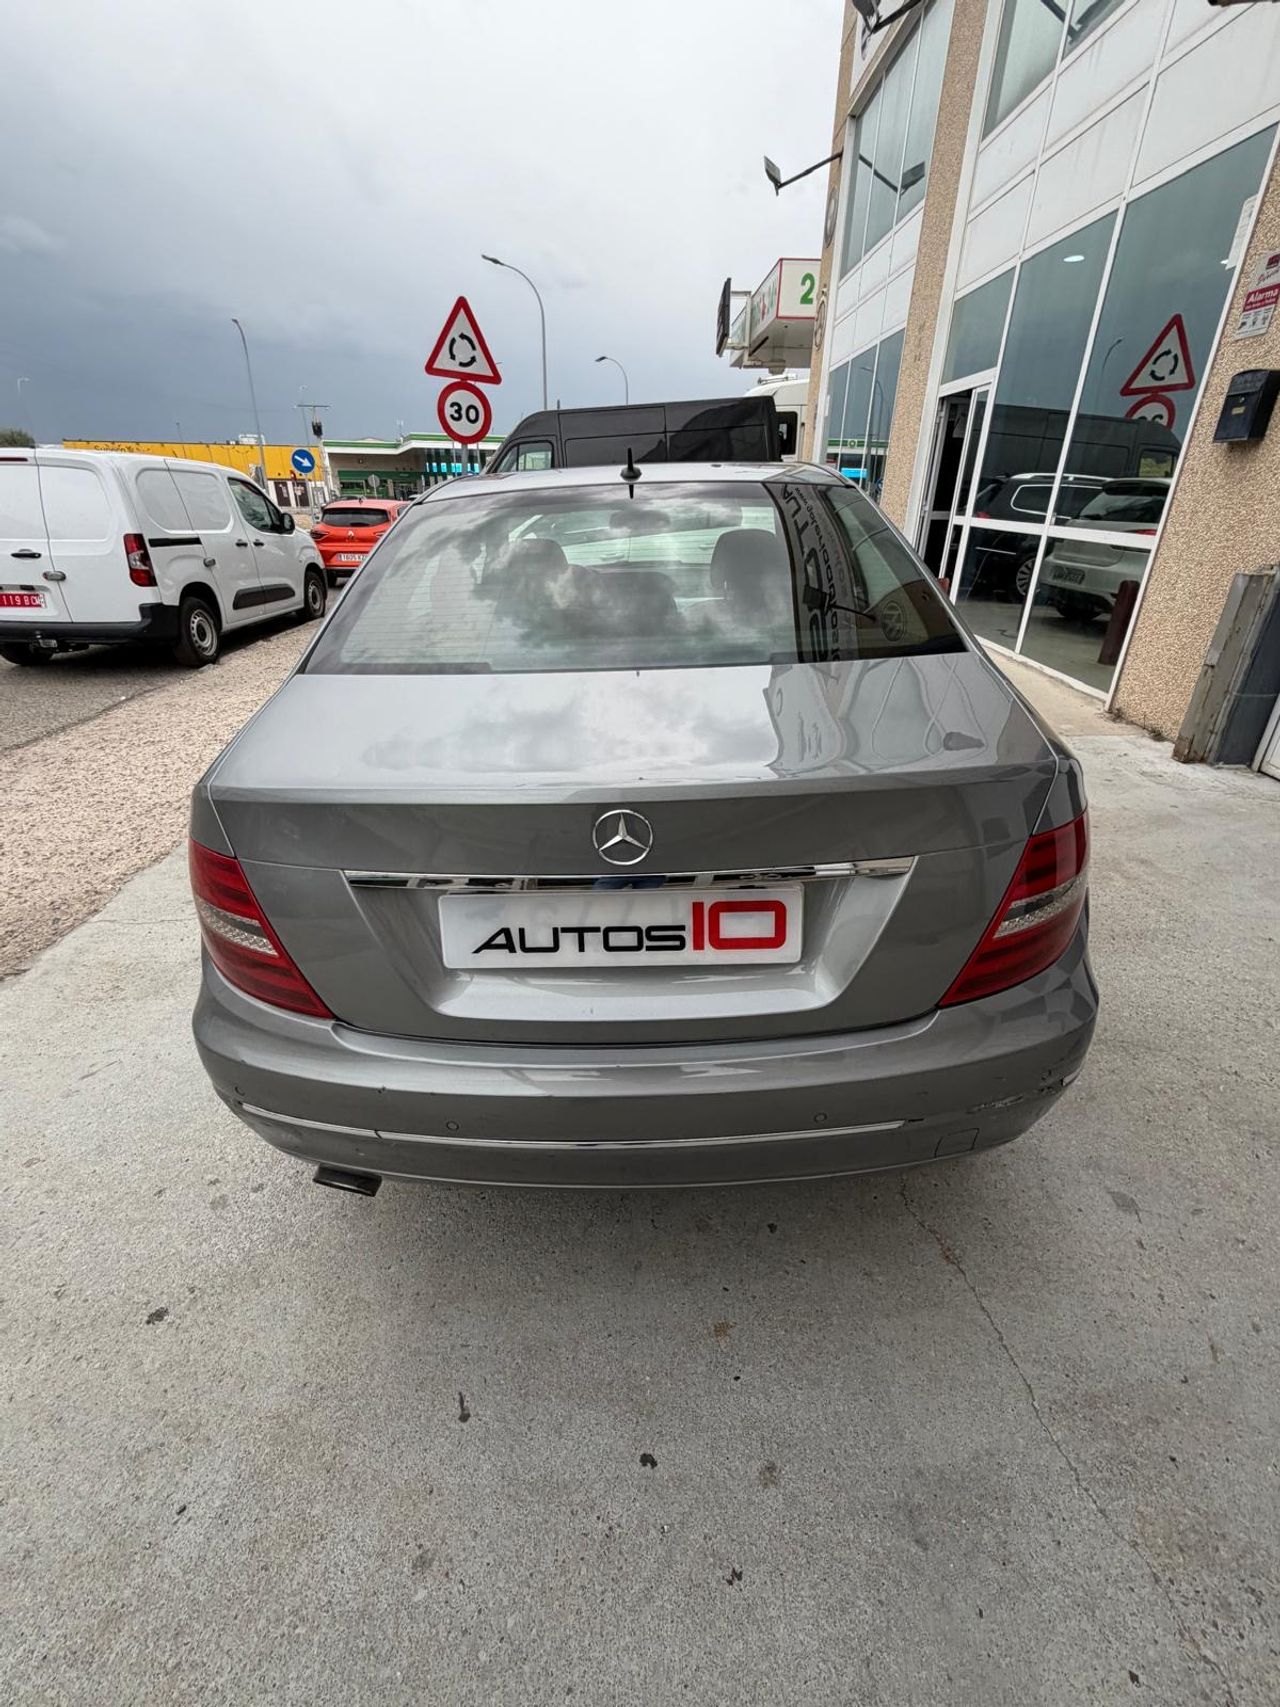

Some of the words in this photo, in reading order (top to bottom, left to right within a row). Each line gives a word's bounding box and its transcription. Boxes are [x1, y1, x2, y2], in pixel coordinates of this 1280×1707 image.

[800, 272, 815, 305] 2
[1246, 288, 1280, 304] Alarma
[449, 401, 480, 424] 30
